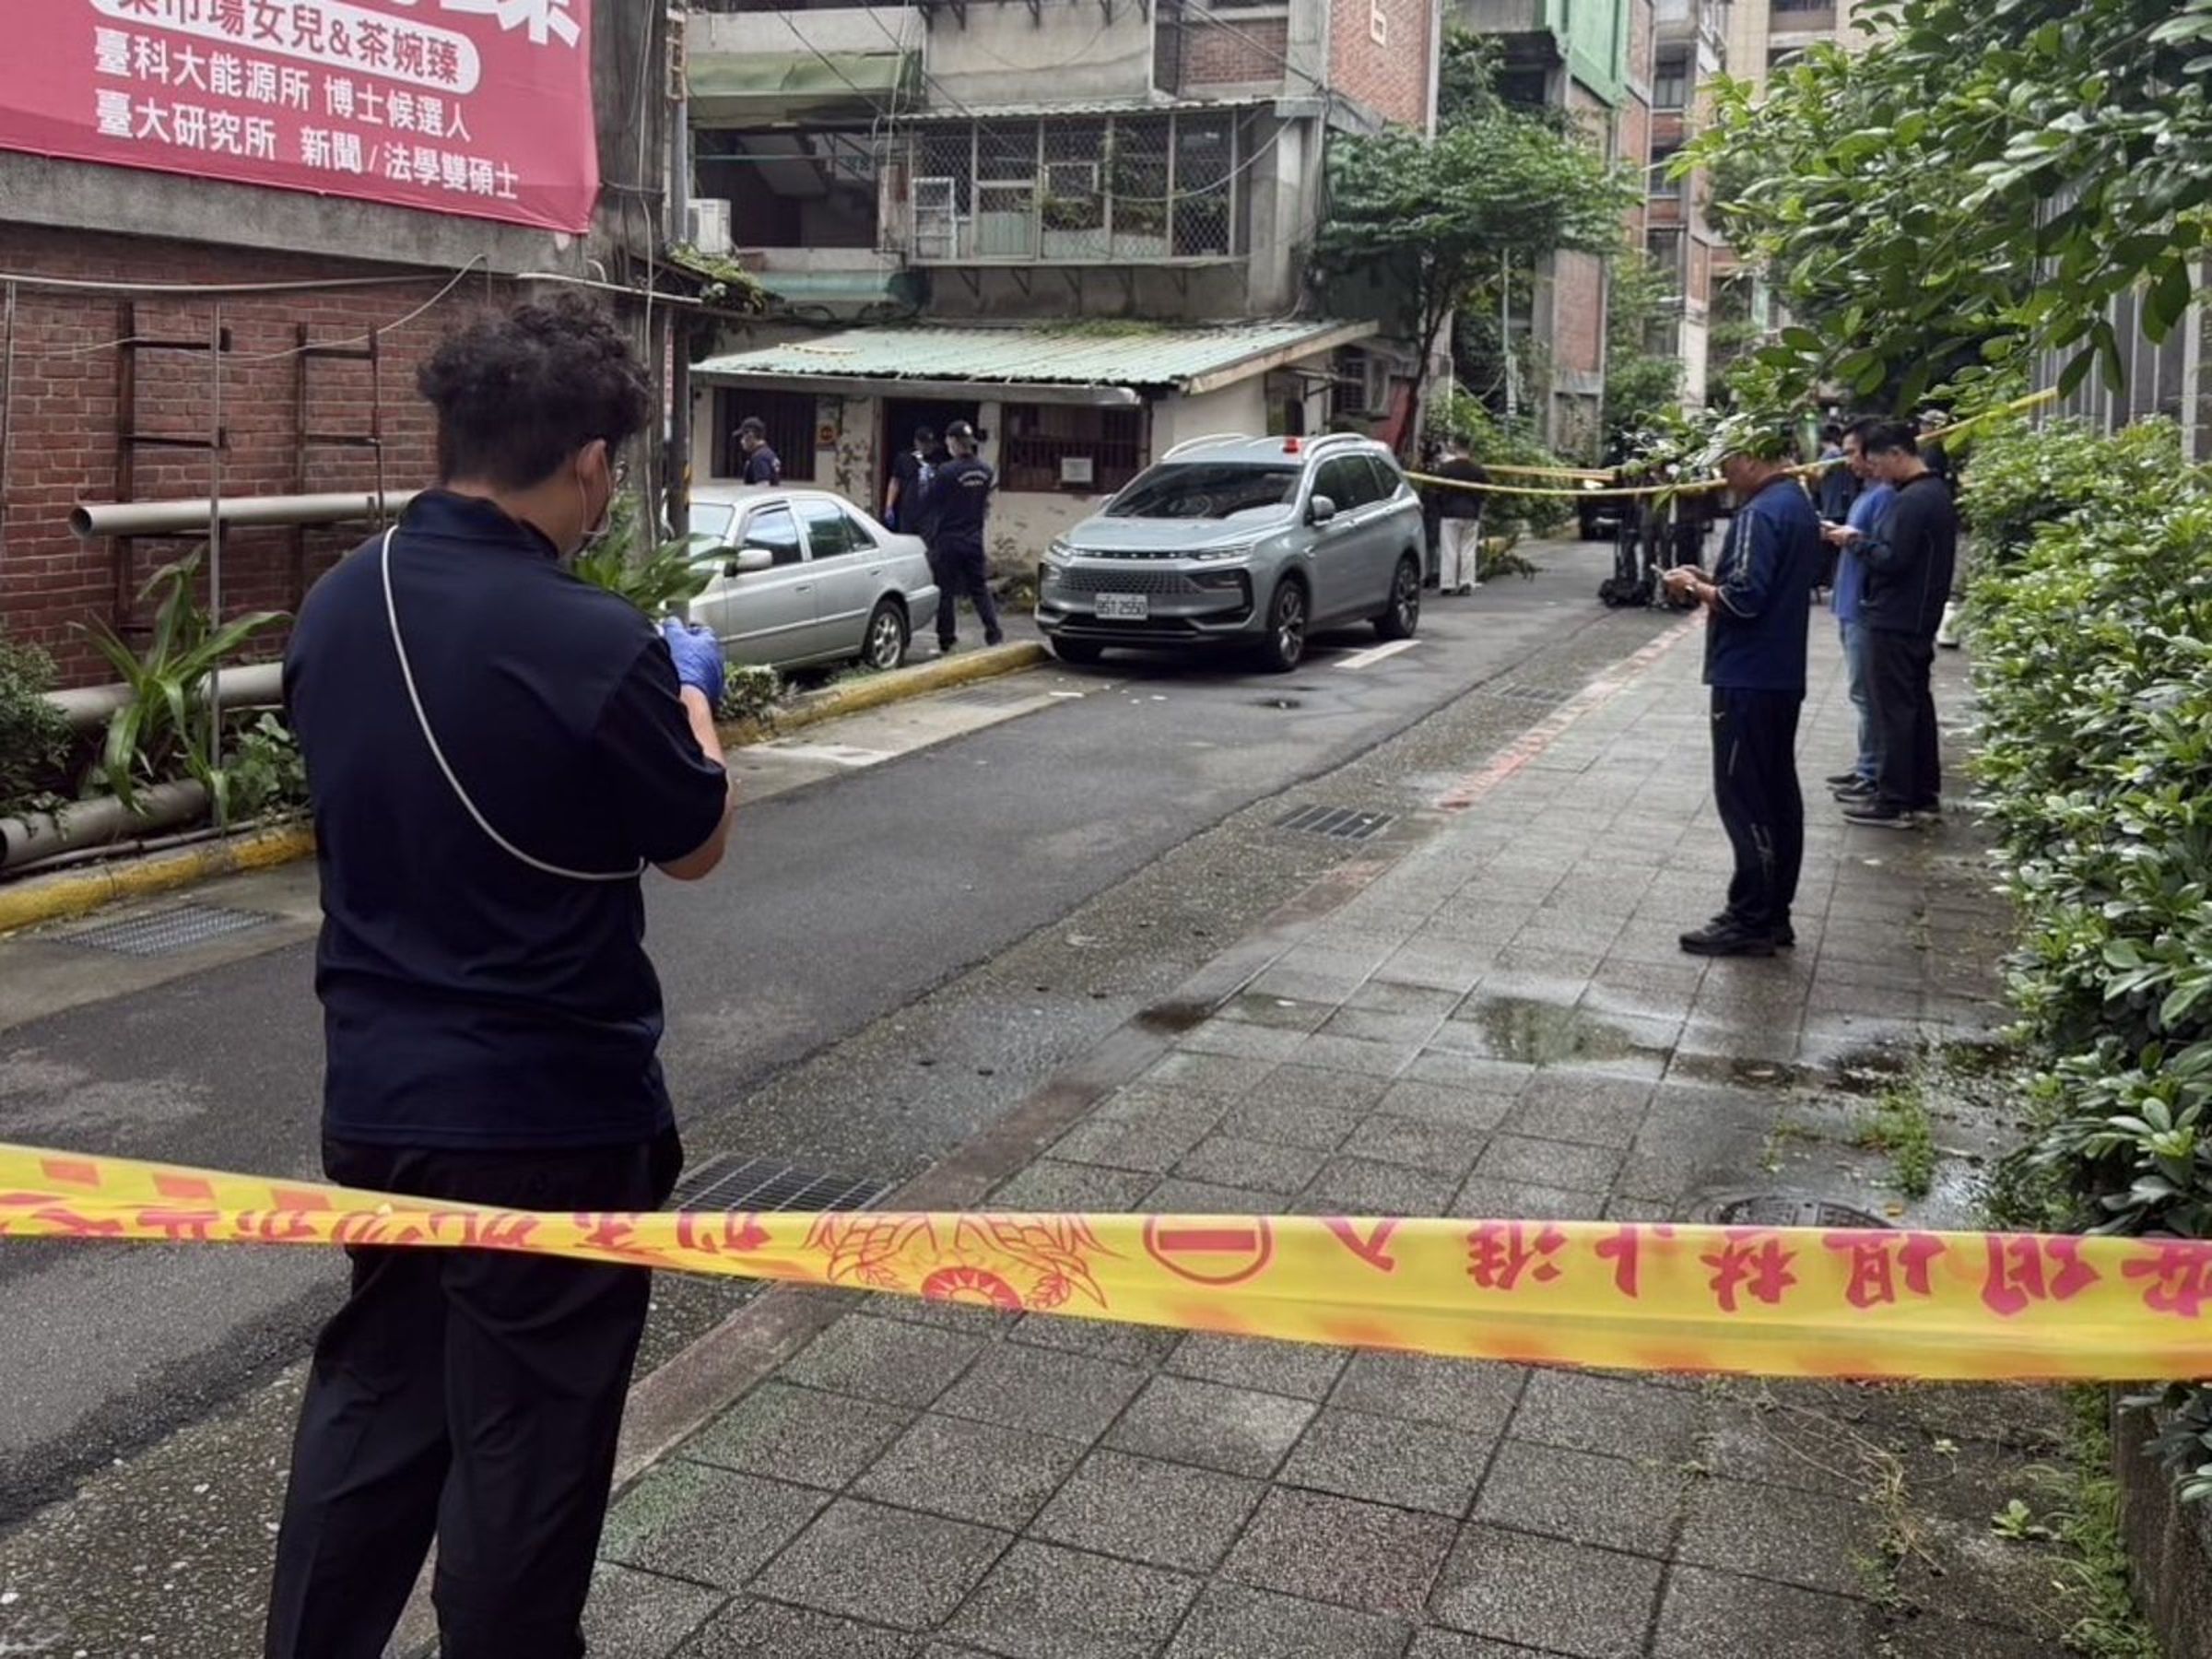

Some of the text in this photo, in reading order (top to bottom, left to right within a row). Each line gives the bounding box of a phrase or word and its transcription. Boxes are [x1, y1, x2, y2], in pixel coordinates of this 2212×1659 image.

[94, 26, 472, 142] 臺科大能源所 博士候選人
[95, 88, 277, 160] 臺大研究所
